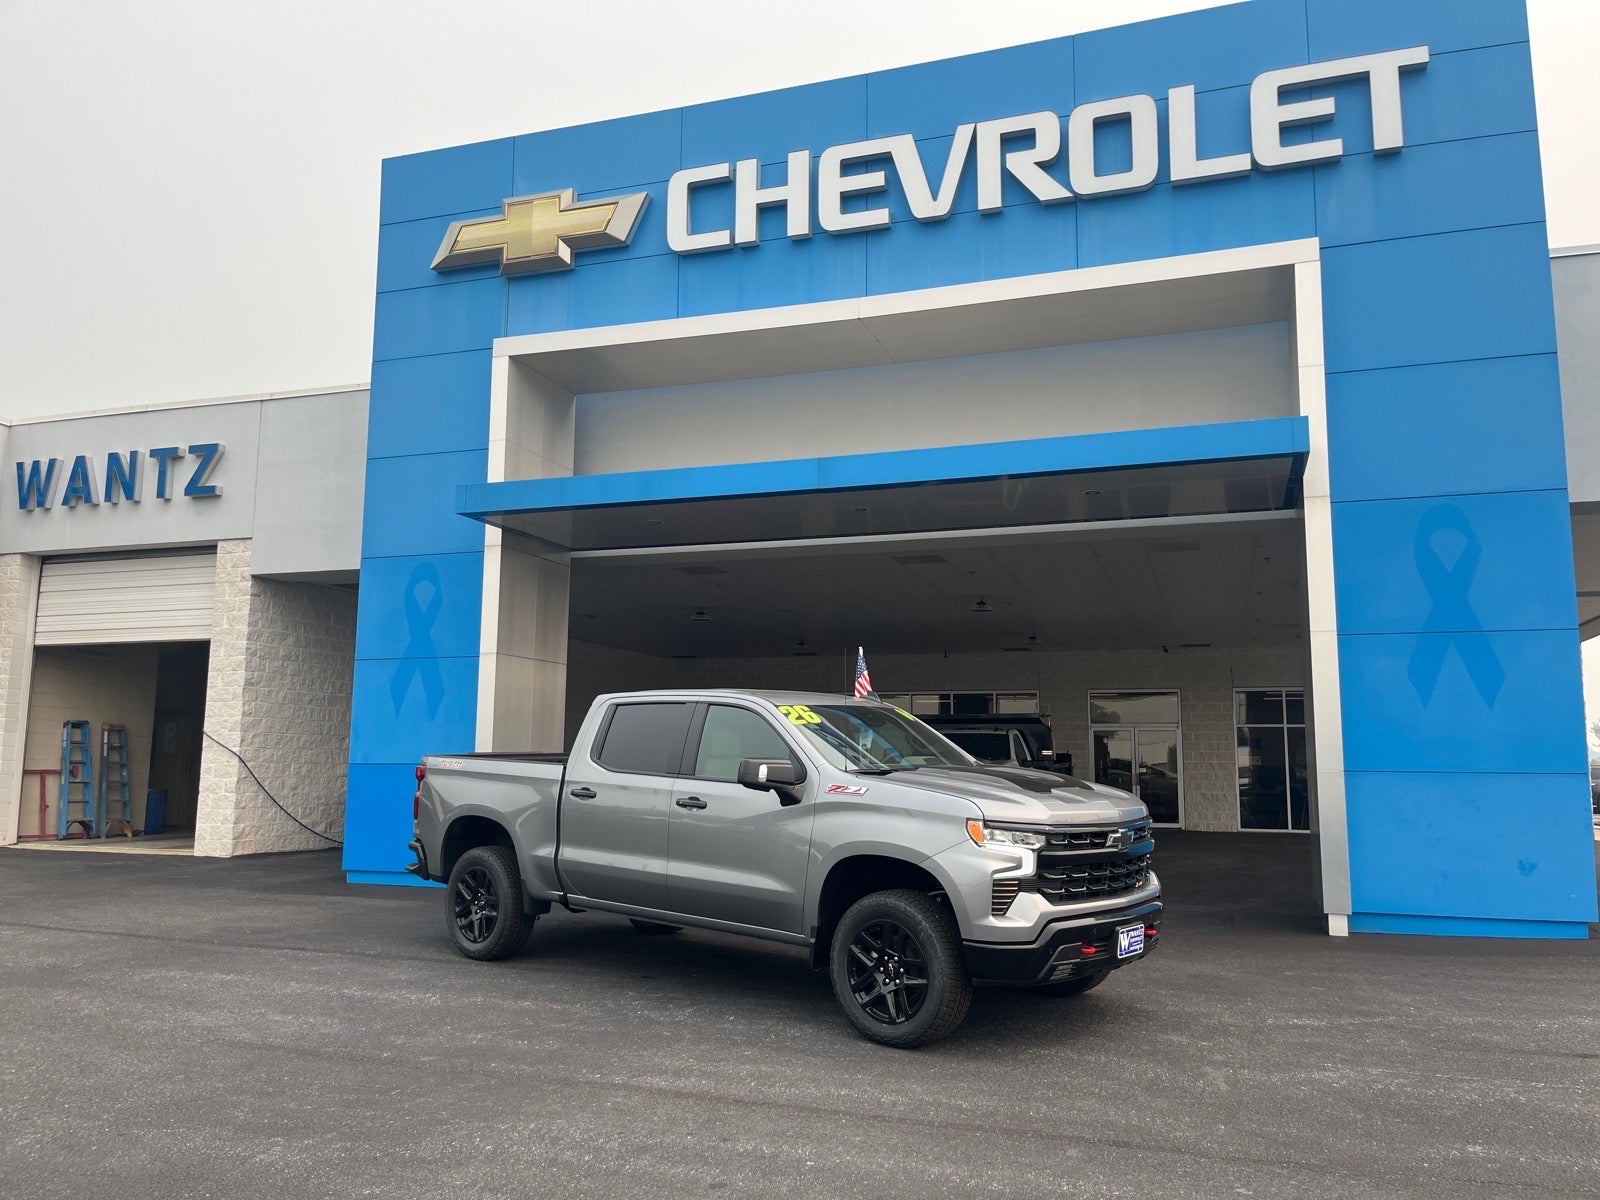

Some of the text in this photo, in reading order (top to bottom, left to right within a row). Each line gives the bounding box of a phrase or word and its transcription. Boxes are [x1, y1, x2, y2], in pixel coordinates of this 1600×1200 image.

[666, 46, 1430, 255] CHEVROLET
[16, 443, 225, 511] WANTZ
[777, 704, 822, 725] 26
